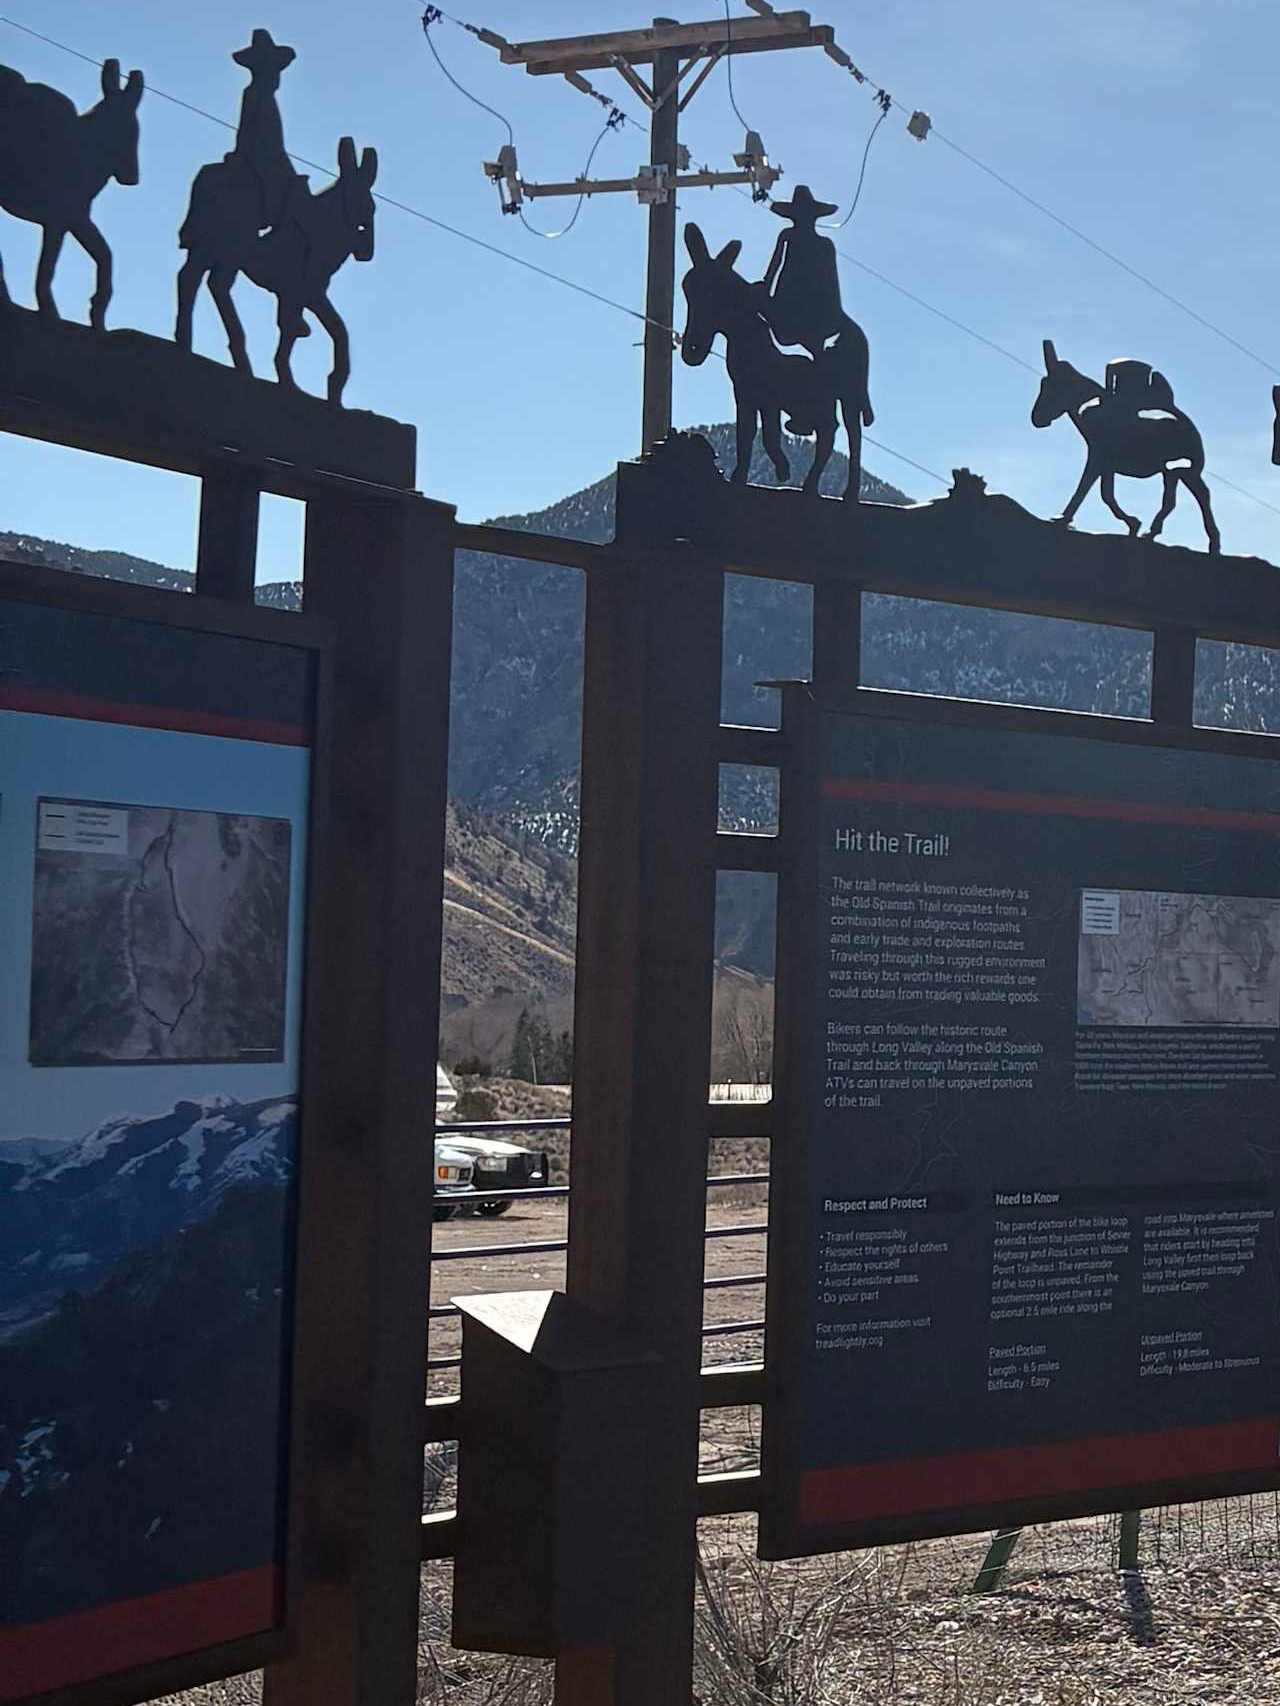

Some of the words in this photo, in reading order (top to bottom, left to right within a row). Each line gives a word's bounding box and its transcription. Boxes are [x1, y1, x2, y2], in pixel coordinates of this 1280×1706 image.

[834, 828, 863, 852] Hit
[868, 830, 899, 854] the
[903, 831, 950, 857] Trail!
[832, 876, 853, 891] The
[855, 877, 877, 892] trail
[878, 878, 922, 894] network
[923, 880, 958, 895] known
[959, 882, 1016, 901] collectively
[1017, 888, 1030, 898] as
[831, 895, 850, 910] the
[851, 896, 870, 910] Old
[872, 897, 915, 915] Spanish
[918, 898, 941, 913] Trail
[942, 899, 993, 918] originates
[995, 901, 1019, 916] from
[831, 914, 899, 930] combination
[900, 916, 912, 930] of
[913, 916, 970, 935] indigenous
[973, 918, 1021, 937] footpaths
[830, 932, 851, 946] and
[852, 932, 881, 949] early
[882, 933, 910, 947] trade
[911, 933, 933, 947] and
[934, 934, 991, 952] exploration
[830, 949, 880, 967] Traveling
[881, 950, 923, 968] through
[925, 951, 945, 965] this
[947, 951, 983, 969] rugged
[984, 952, 1046, 967] environment
[829, 972, 852, 982] was
[853, 969, 879, 985] risky
[881, 969, 900, 983] but
[901, 970, 933, 984] worth
[935, 970, 952, 984] the
[953, 971, 975, 984] rich
[975, 971, 1016, 985] rewards
[1017, 976, 1037, 986] one
[828, 986, 859, 999] could
[860, 987, 896, 1000] obtain
[897, 988, 923, 1001] from
[925, 988, 962, 1005] trading
[963, 989, 1007, 1003] valuable
[826, 1021, 862, 1036] Bikers
[863, 1026, 884, 1036] can
[886, 1022, 919, 1036] follow
[920, 1023, 938, 1036] the
[939, 1023, 978, 1036] historic
[980, 1024, 1008, 1037] route
[826, 1040, 870, 1056] through
[871, 1040, 899, 1056] Long
[901, 1041, 933, 1057] Valley
[934, 1041, 964, 1057] along
[965, 1041, 983, 1054] the
[984, 1041, 1001, 1054] Old
[1002, 1042, 1044, 1058] Spanish
[826, 1058, 851, 1071] Trail
[852, 1058, 873, 1071] and
[875, 1058, 902, 1071] back
[903, 1058, 945, 1074] through
[946, 1058, 999, 1074] Marysvale
[825, 1077, 855, 1090] ATVs
[856, 1080, 878, 1090] can
[879, 1077, 910, 1090] travel
[927, 1077, 945, 1089] the
[947, 1077, 990, 1092] unpaved
[992, 1077, 1033, 1092] portions
[824, 1093, 837, 1107] of
[839, 1093, 857, 1107] the
[824, 1197, 867, 1214] Respect
[868, 1197, 888, 1210] and
[890, 1196, 928, 1210] Protect
[995, 1193, 1020, 1205] Need
[1021, 1193, 1032, 1205] to
[1033, 1192, 1060, 1204] Know
[995, 1220, 1011, 1231] The
[1011, 1219, 1037, 1233] paved
[1038, 1218, 1068, 1232] portion
[1068, 1218, 1079, 1228] of
[1079, 1217, 1092, 1228] the
[1110, 1216, 1128, 1229] loop
[826, 1230, 854, 1242] Travel
[855, 1228, 908, 1243] responsibly
[825, 1245, 863, 1259] Respect
[864, 1244, 880, 1255] the
[881, 1243, 907, 1257] rights
[908, 1243, 919, 1254] of
[919, 1242, 949, 1253] others
[825, 1260, 863, 1272] Educate
[863, 1258, 901, 1273] yourself
[823, 1275, 851, 1287] Avoid
[851, 1273, 893, 1285] sensitive
[893, 1275, 919, 1283] areas
[823, 1292, 836, 1303] Do
[837, 1294, 859, 1305] your
[860, 1291, 880, 1304] part
[816, 1322, 832, 1334] For
[833, 1323, 858, 1333] more
[859, 1317, 911, 1331] information
[912, 1316, 931, 1327] visit
[988, 1363, 1017, 1379] Length
[1037, 1360, 1061, 1373] miles
[987, 1377, 1024, 1393] Difficulty
[1030, 1375, 1051, 1390] Easy
